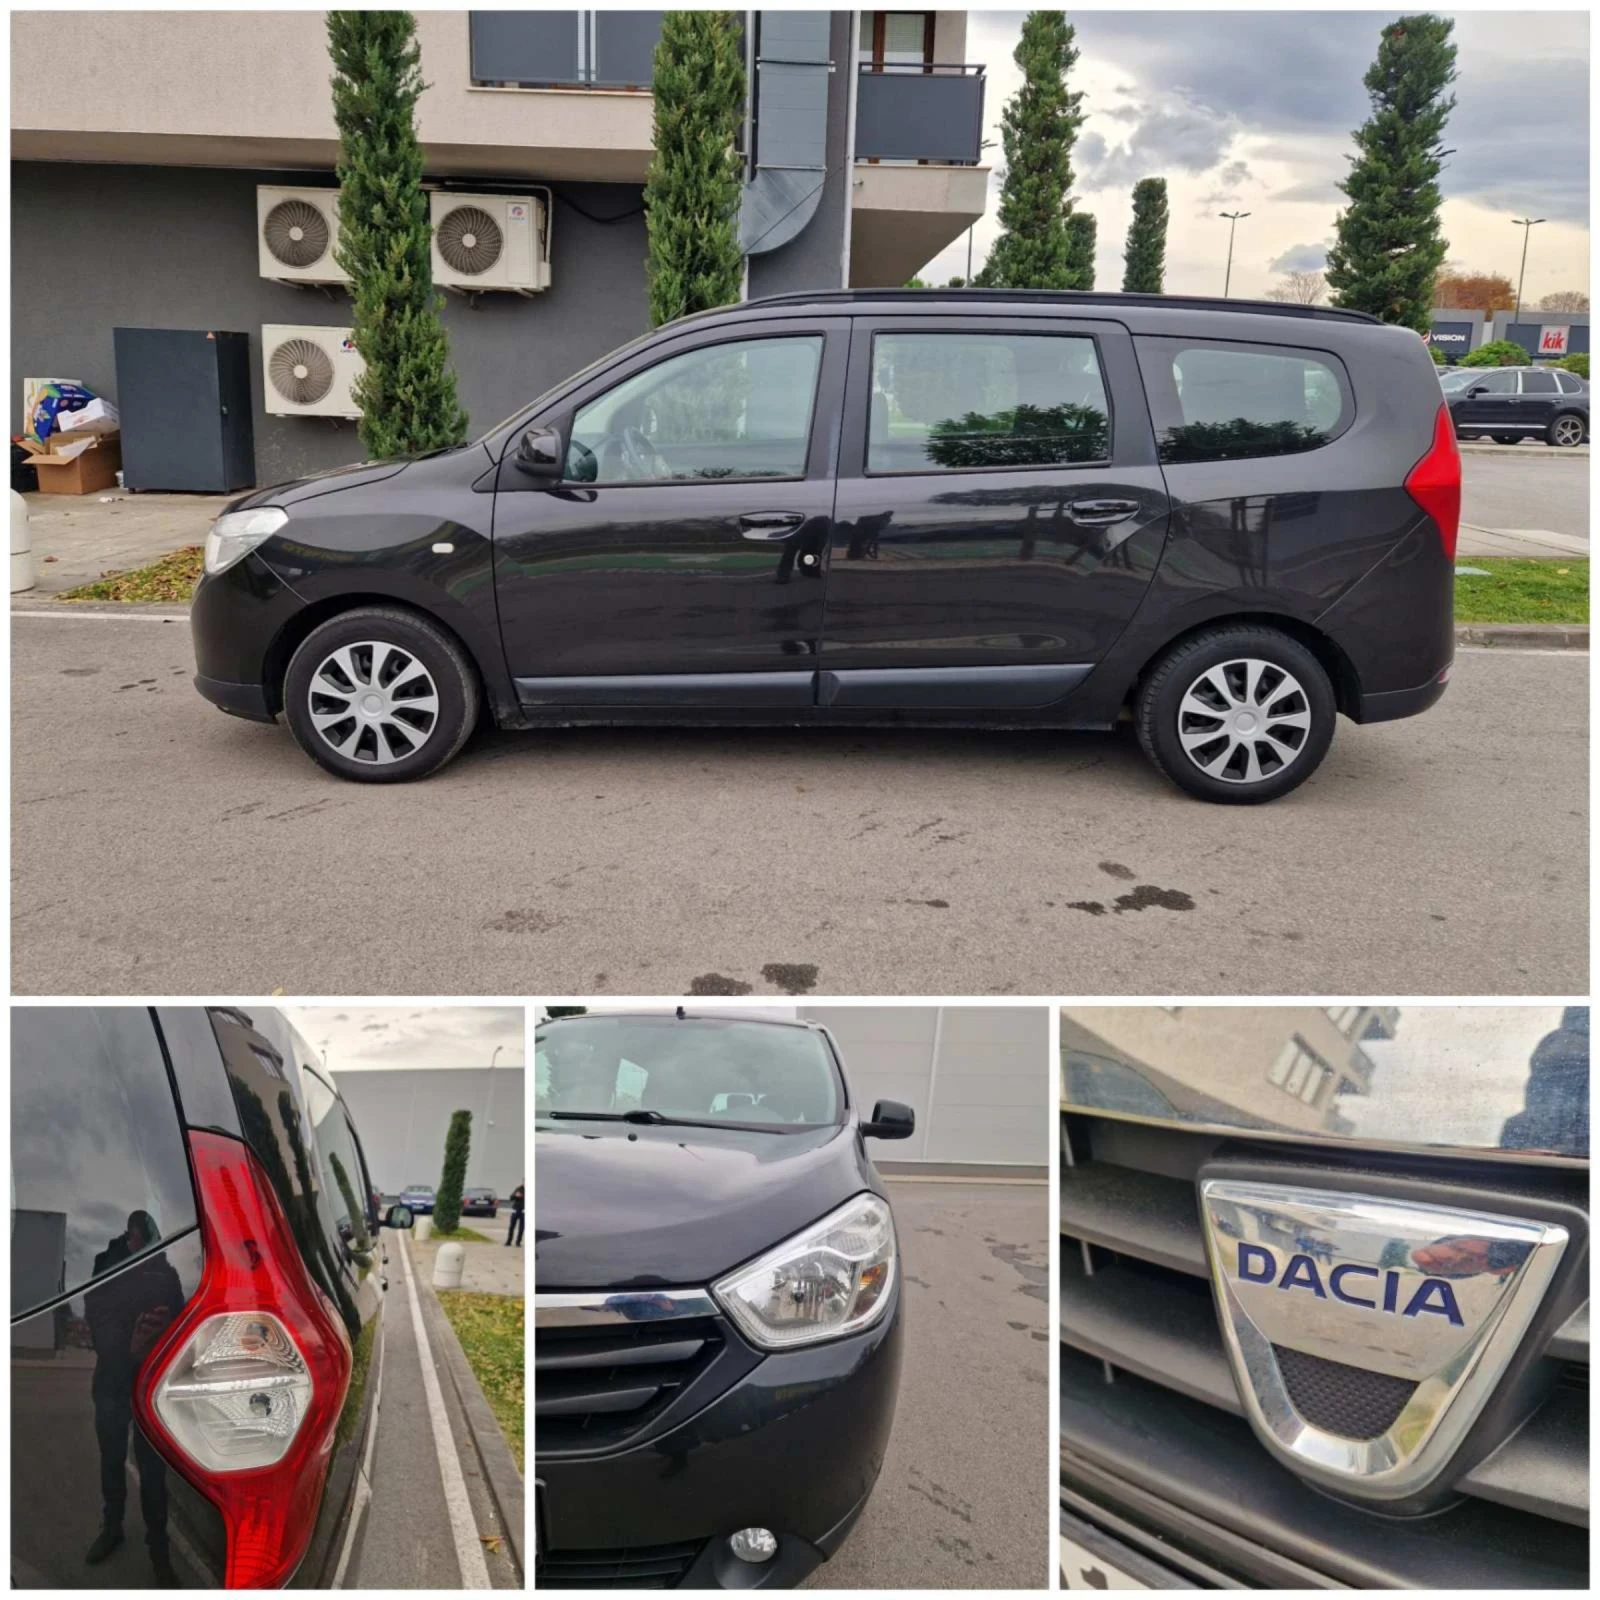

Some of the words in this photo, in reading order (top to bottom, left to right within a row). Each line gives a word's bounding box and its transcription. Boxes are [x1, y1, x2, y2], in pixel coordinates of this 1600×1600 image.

[1432, 334, 1465, 342] VISION
[1543, 331, 1565, 349] kik
[1237, 1242, 1464, 1327] DACIA
